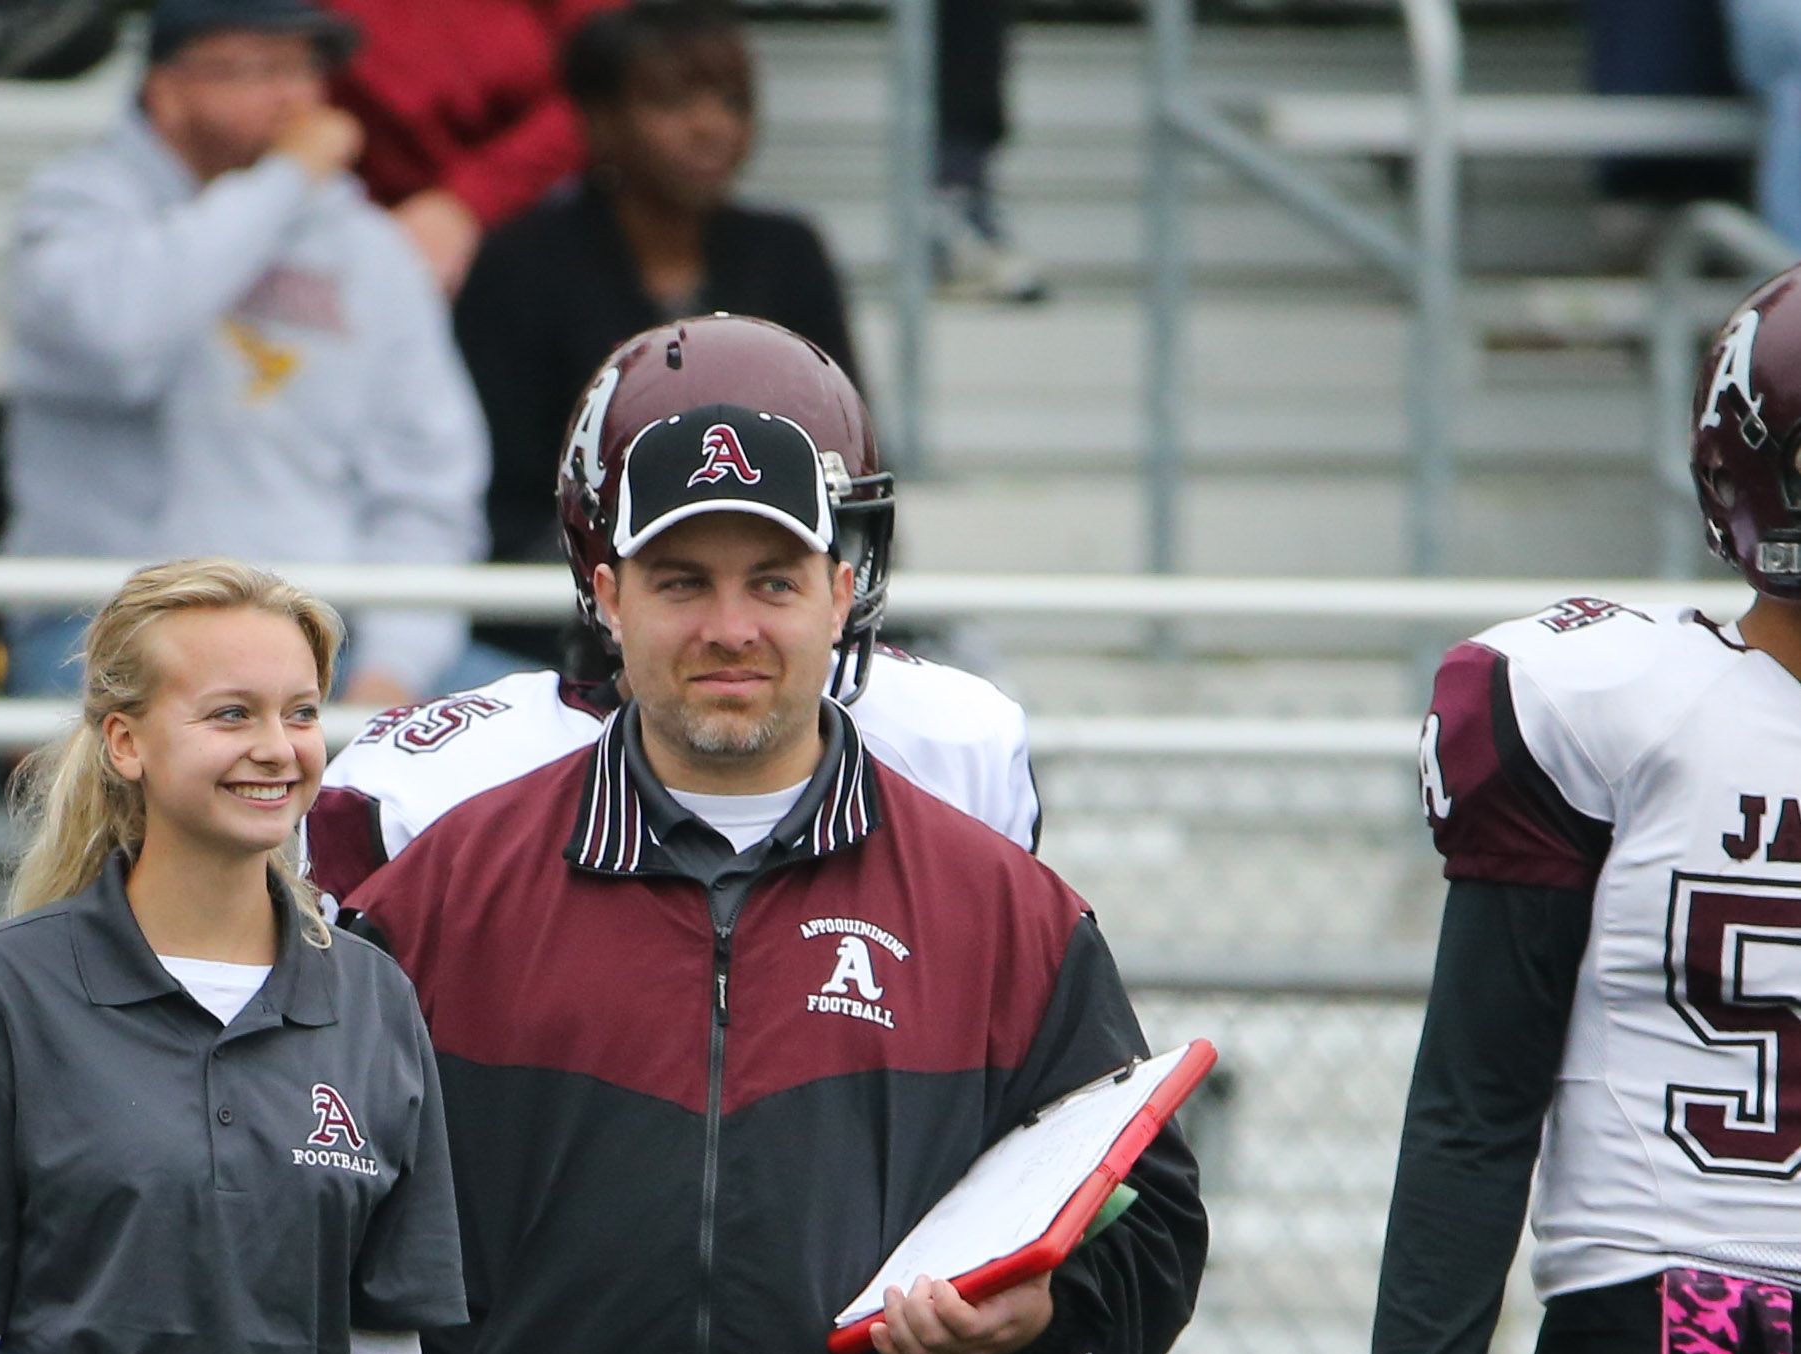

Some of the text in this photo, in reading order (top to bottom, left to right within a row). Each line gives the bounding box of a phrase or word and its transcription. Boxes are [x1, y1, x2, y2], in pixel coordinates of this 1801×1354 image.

[686, 423, 762, 488] A
[820, 935, 884, 1001] A
[806, 994, 896, 1030] FOOTBALL
[306, 1082, 366, 1151] A
[291, 1148, 379, 1176] FOOTBALL
